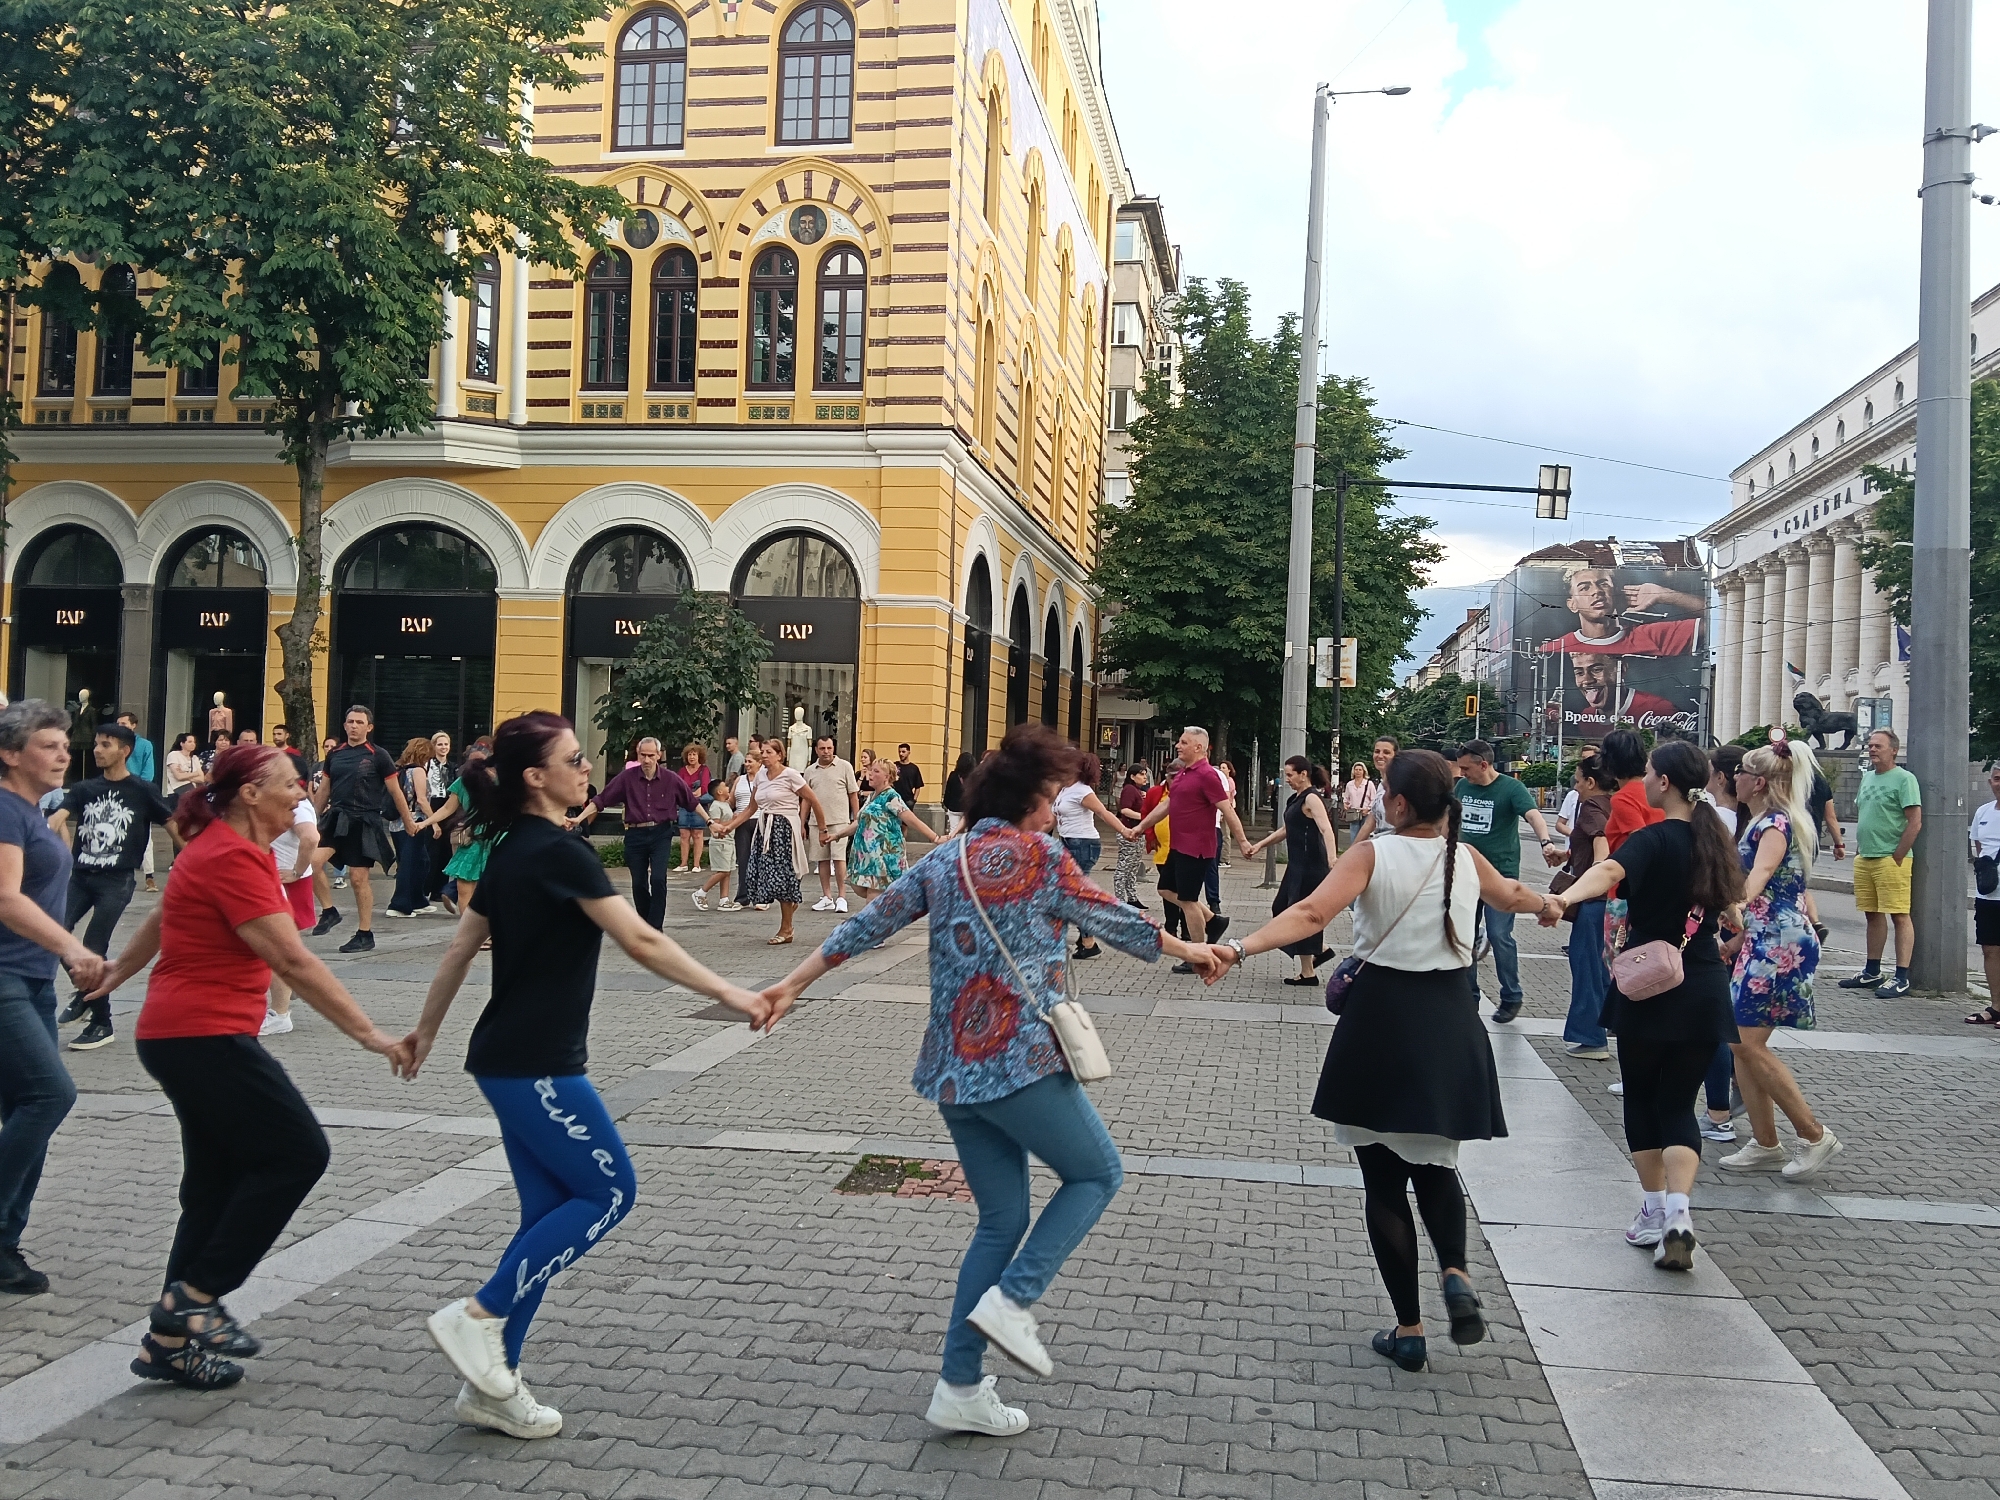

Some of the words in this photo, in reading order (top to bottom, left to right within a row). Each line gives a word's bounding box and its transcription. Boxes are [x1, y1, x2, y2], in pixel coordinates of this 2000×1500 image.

[1784, 487, 1852, 535] СЪДЕБНА
[56, 610, 84, 624] PAP
[200, 612, 229, 626] PAP
[401, 617, 432, 632] PAP
[780, 624, 813, 639] PAP
[1564, 710, 1606, 725] Време
[1621, 716, 1634, 724] за
[534, 1076, 592, 1141] ave
[592, 1148, 616, 1178] a
[512, 1246, 575, 1304] day
